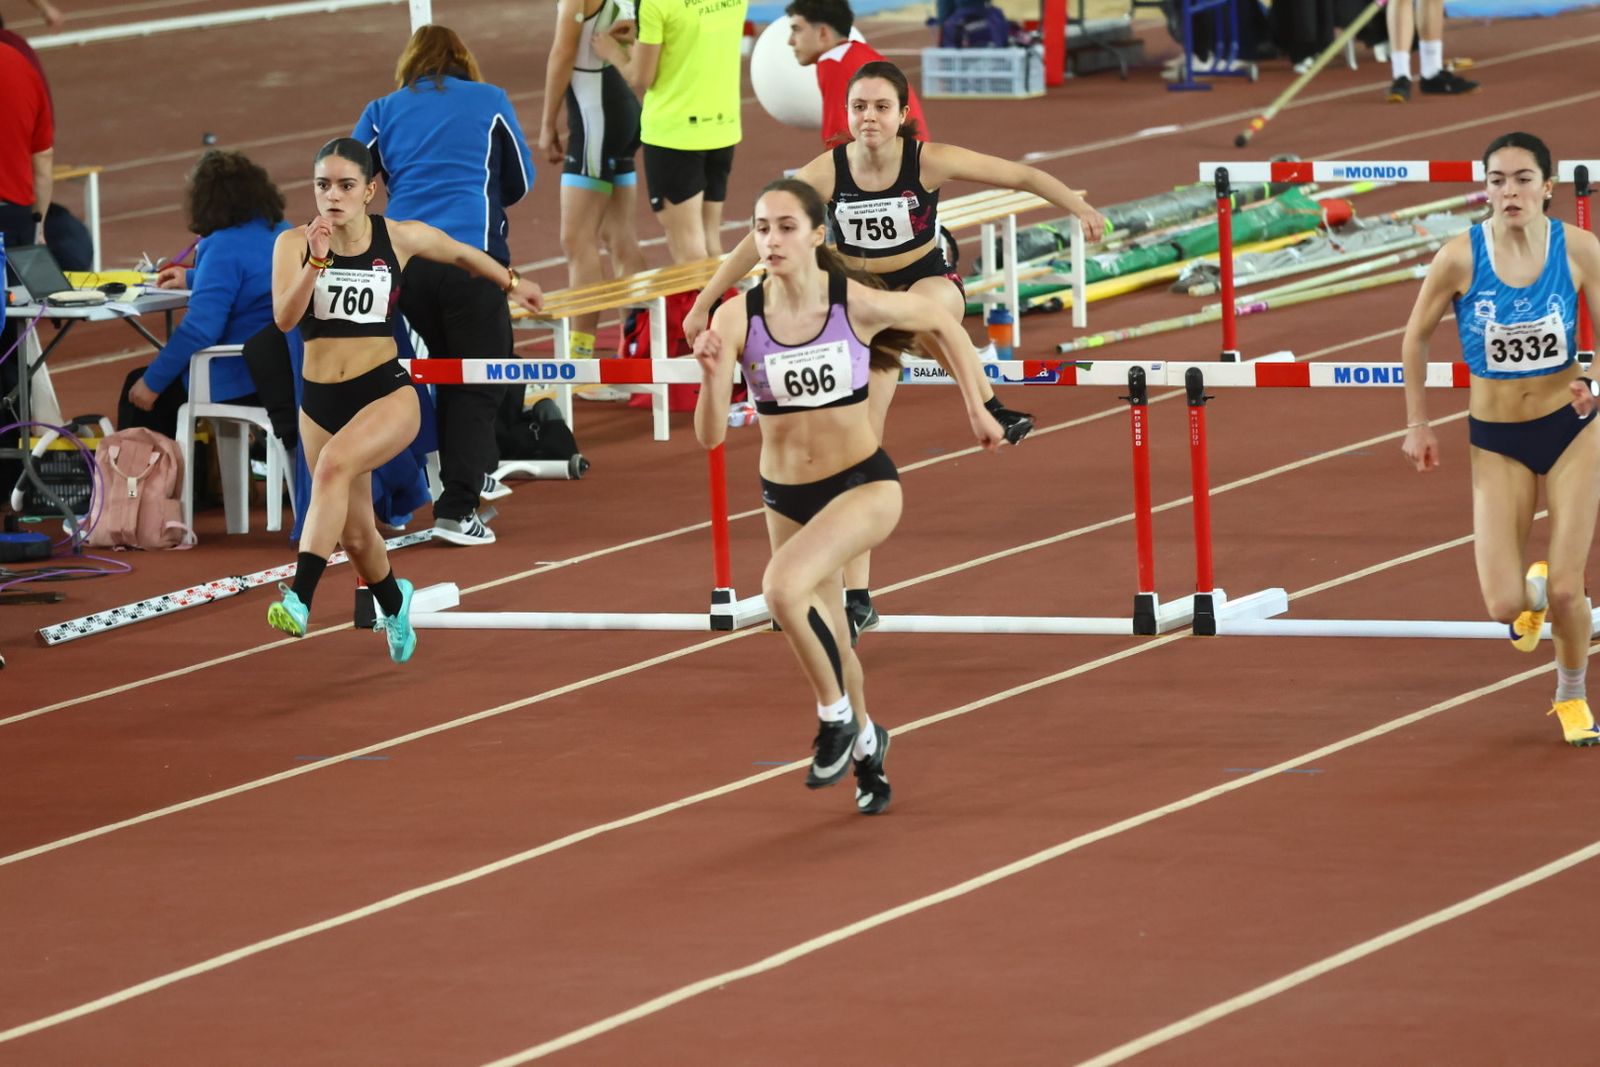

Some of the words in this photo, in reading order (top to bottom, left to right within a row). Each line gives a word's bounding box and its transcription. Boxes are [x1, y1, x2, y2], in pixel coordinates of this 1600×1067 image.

[698, 0, 742, 16] PALENCIA
[1346, 167, 1408, 178] MONDO
[849, 216, 897, 241] 758
[328, 285, 374, 316] 760
[1491, 333, 1558, 363] 3332
[486, 363, 575, 380] MONDO
[784, 363, 836, 397] 696
[1334, 367, 1404, 383] MOND
